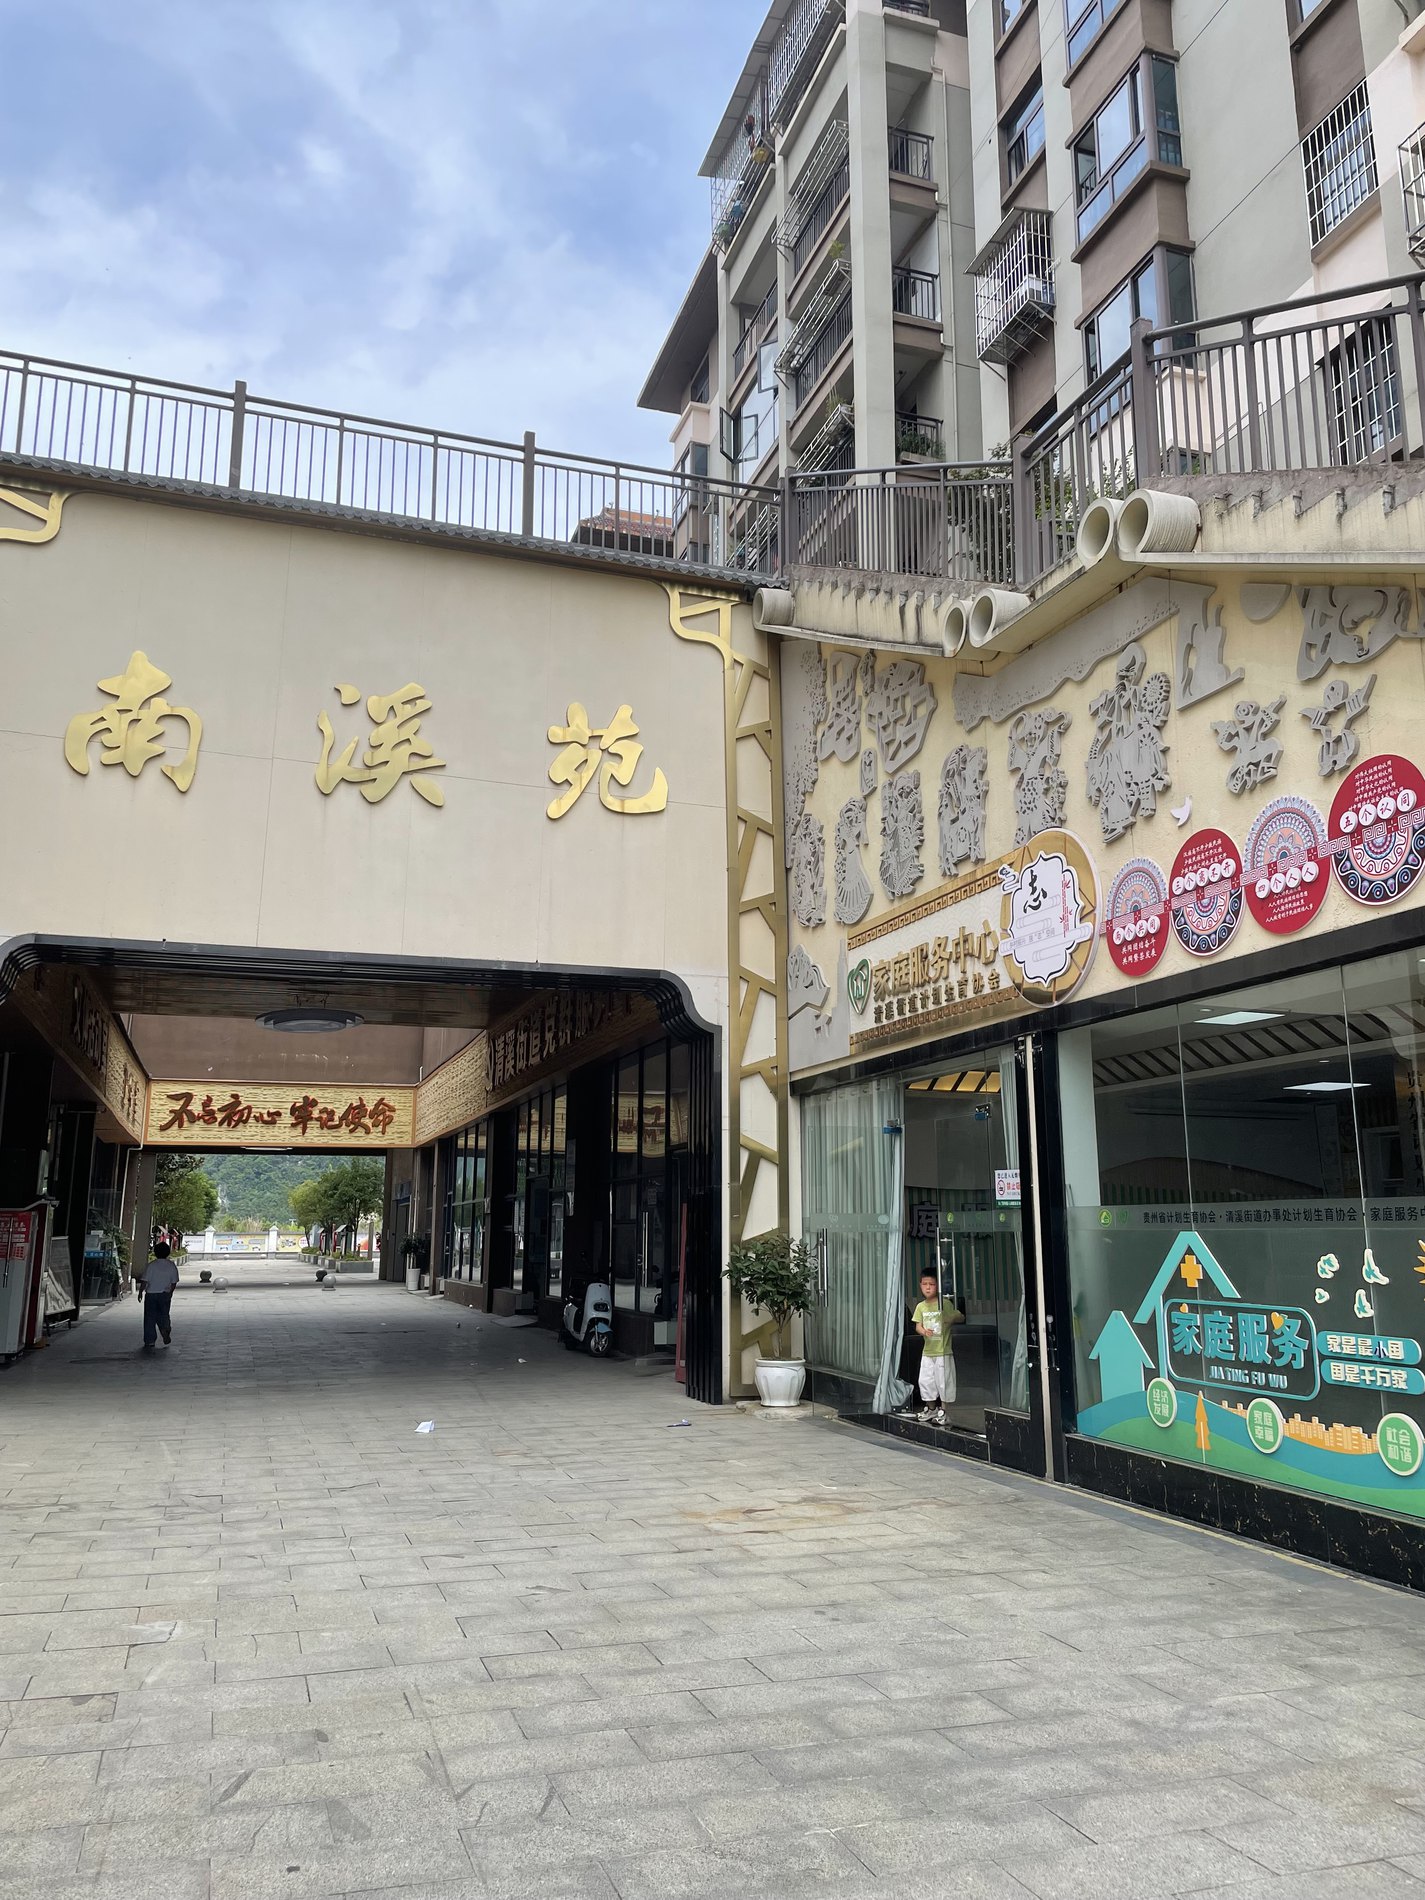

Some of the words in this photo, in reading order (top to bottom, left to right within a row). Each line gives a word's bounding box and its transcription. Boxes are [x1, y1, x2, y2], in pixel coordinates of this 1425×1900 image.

[64, 650, 668, 820] 南溪苑
[1343, 793, 1412, 830] 五个认同
[1174, 860, 1233, 890] 三个离不开
[1257, 865, 1316, 893] 四个人人
[1121, 937, 1156, 954] 共同团结奋斗
[1122, 948, 1157, 966] 共同繁荣发展
[873, 919, 1000, 1002] 家庭服务中心
[874, 968, 1000, 1024] 清溪街道计划生育协会
[159, 1091, 282, 1131] 不忘初心
[290, 1095, 396, 1135] 牢记使命
[1171, 1311, 1309, 1369] 家庭服务
[1326, 1334, 1405, 1360] 家是最小国
[1251, 1371, 1266, 1386] FU
[1268, 1373, 1288, 1389] WU
[1330, 1362, 1408, 1390] 国是千万家
[1153, 1402, 1170, 1418] 发展
[1386, 1427, 1411, 1446] 社会
